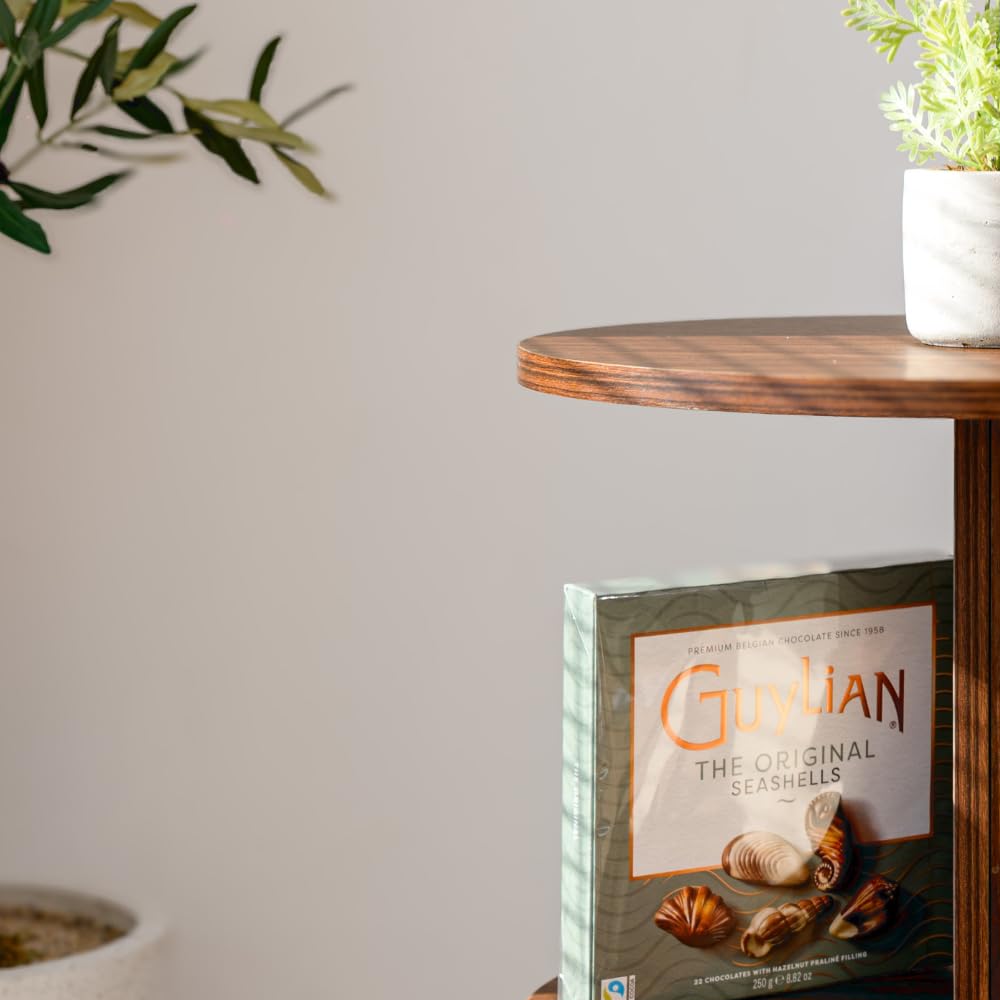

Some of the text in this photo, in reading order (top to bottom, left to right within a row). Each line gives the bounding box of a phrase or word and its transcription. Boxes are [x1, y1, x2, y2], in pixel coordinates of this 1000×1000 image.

[688, 626, 885, 655] PREMIUM BELGIAN CHOCOLATE SINCE 1958
[695, 739, 876, 781] THE ORIGINAL
[731, 767, 841, 796] SEASHELLS
[704, 970, 751, 984] CHOCOLATES
[752, 967, 771, 976] WITH
[772, 960, 809, 972] HAZELNUT
[841, 951, 868, 961] FILLING
[752, 977, 767, 990] 250
